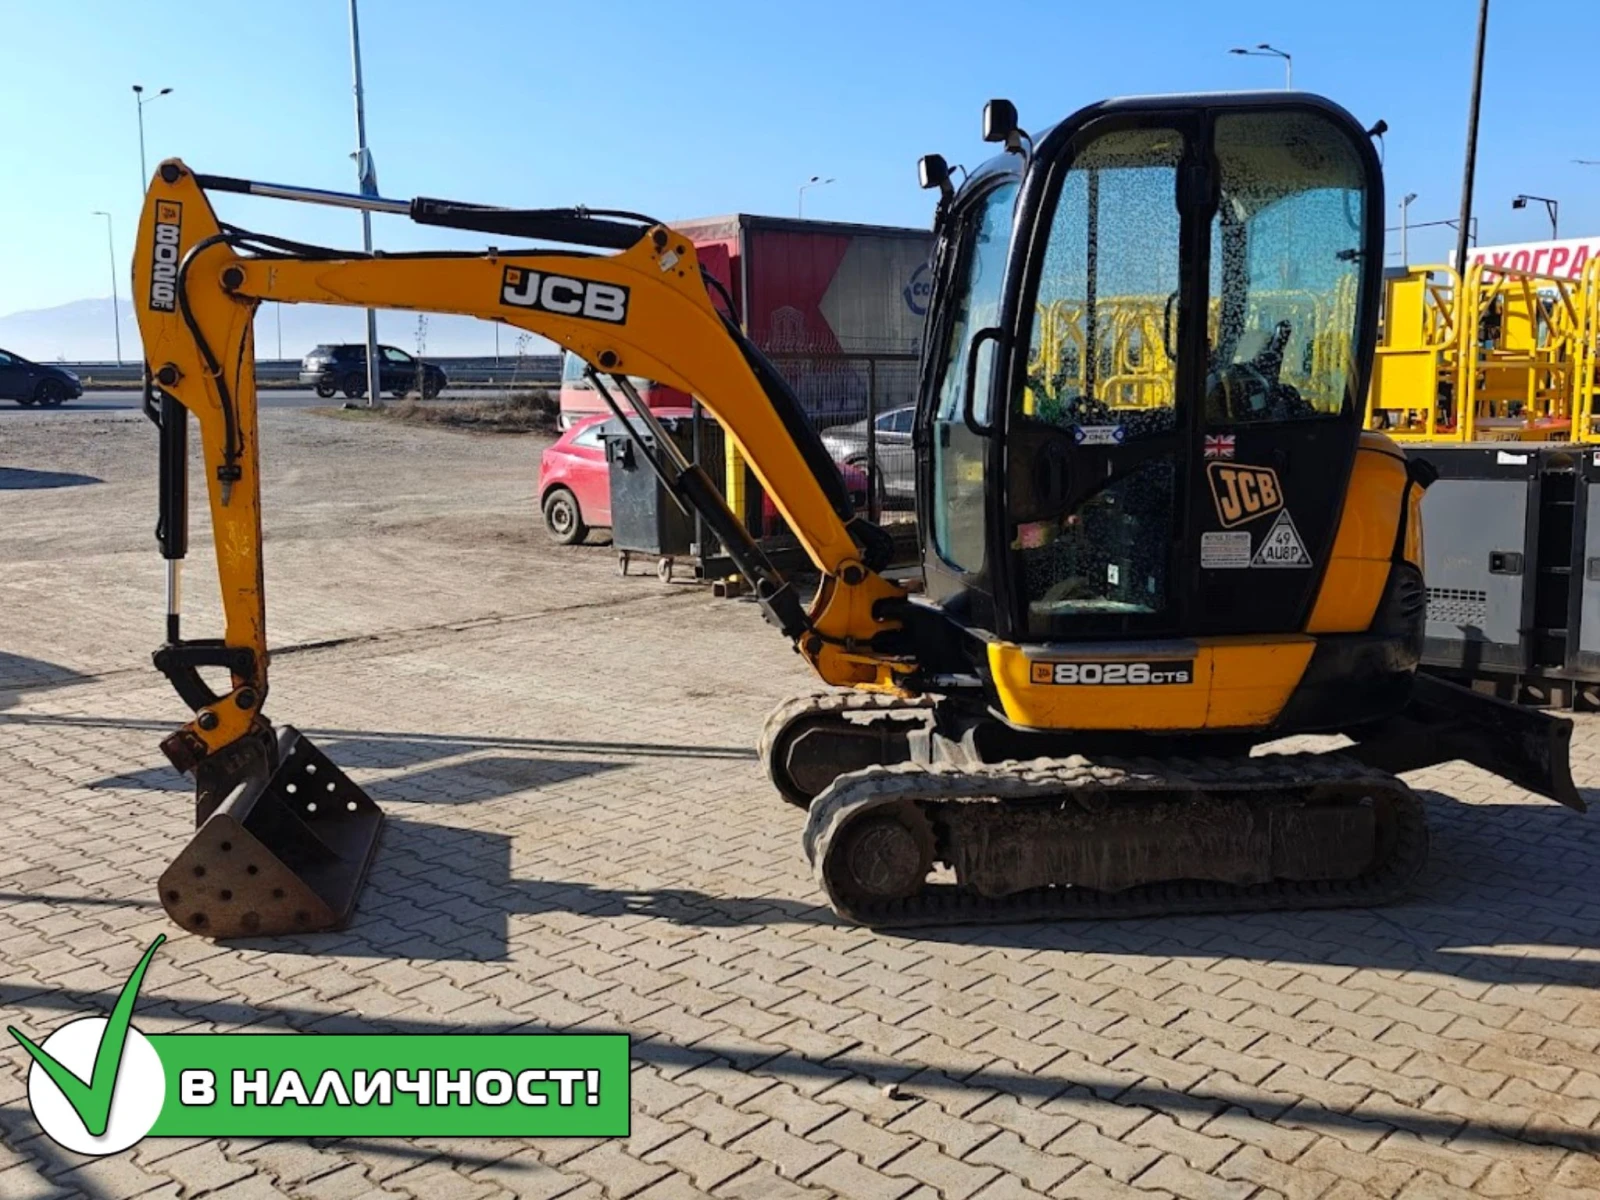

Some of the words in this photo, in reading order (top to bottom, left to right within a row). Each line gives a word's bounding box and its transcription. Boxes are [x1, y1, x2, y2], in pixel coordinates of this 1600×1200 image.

[152, 224, 180, 302] 8026
[503, 271, 626, 321] JCB
[1219, 468, 1278, 521] JCB
[1276, 532, 1291, 545] 49
